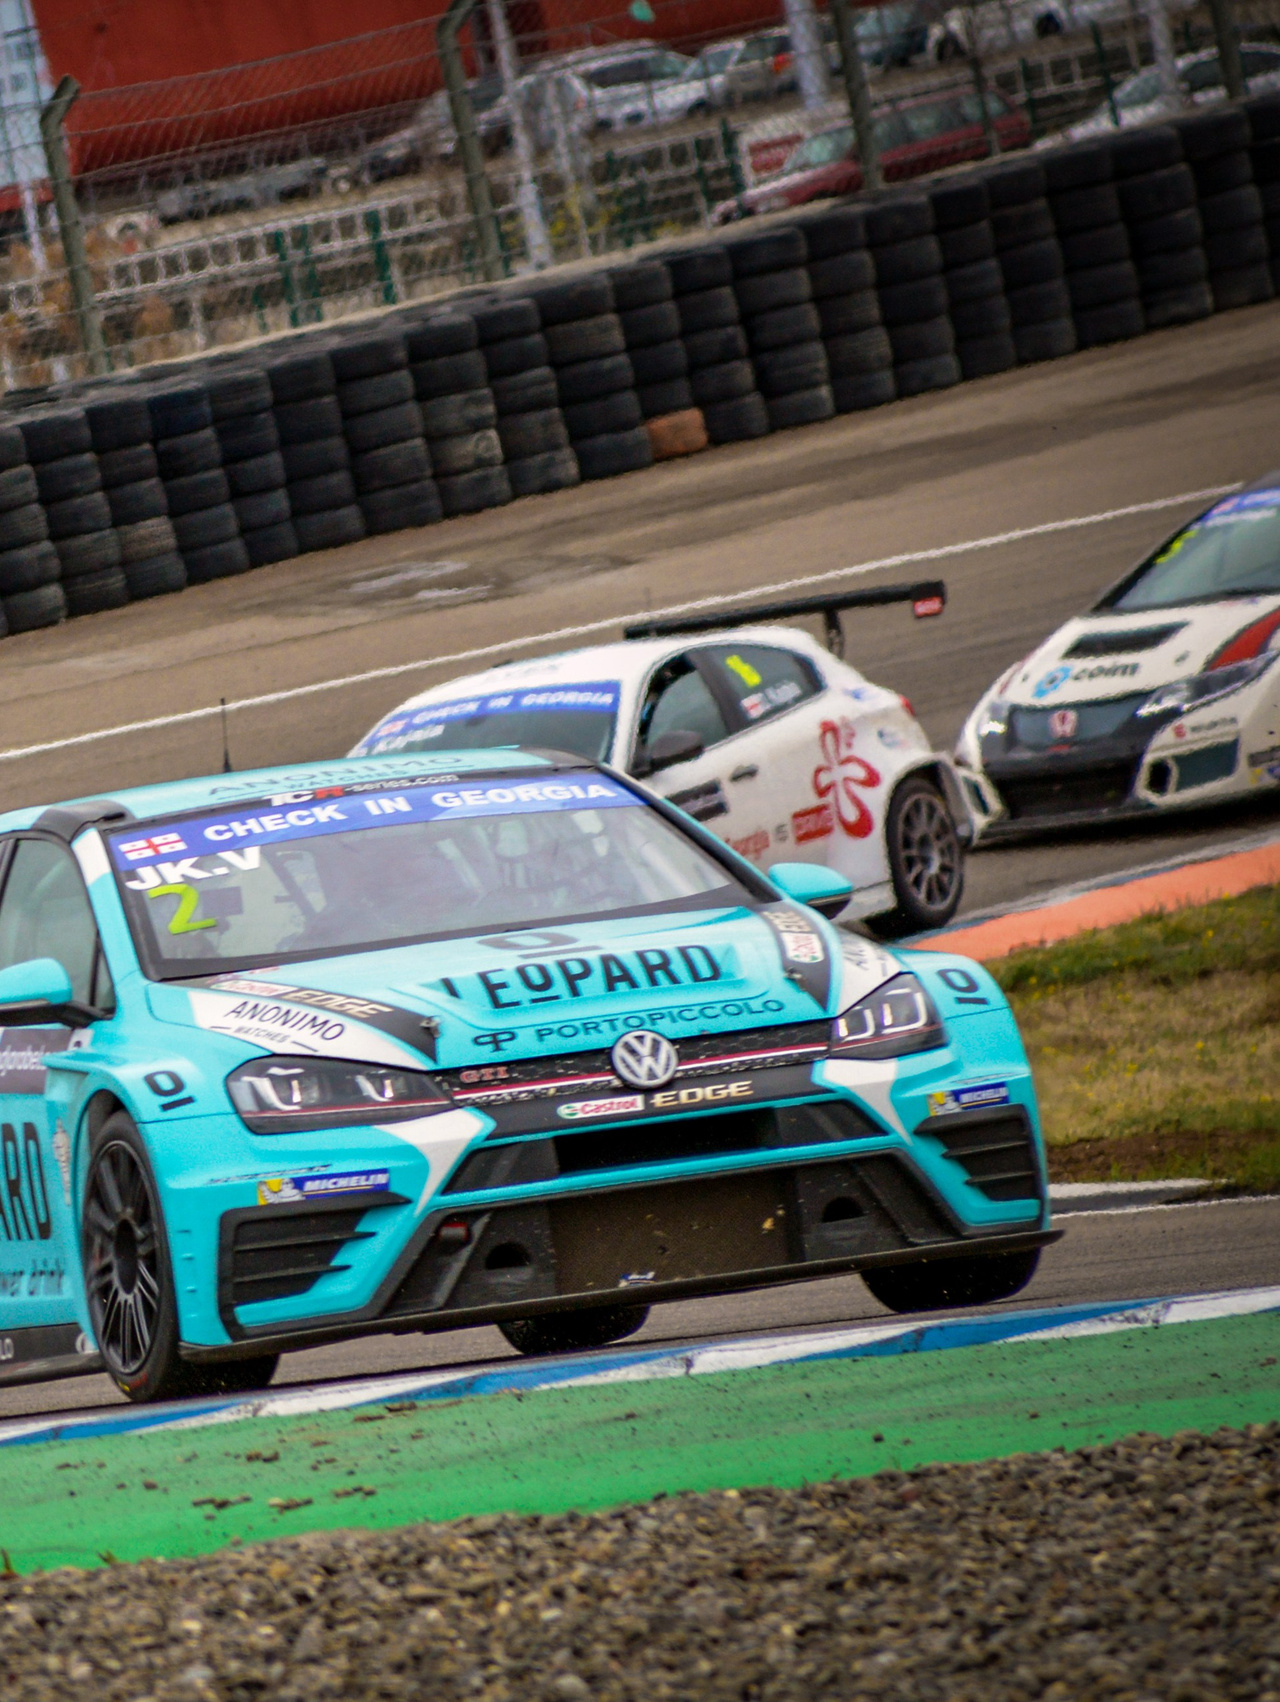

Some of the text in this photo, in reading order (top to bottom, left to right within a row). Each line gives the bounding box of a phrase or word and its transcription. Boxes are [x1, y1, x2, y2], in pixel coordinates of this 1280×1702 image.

[520, 690, 615, 706] GEORGIA
[202, 782, 618, 842] CHECK IN GEORGIA
[148, 883, 216, 936] 2
[438, 944, 722, 1010] LEOPARD
[223, 1001, 346, 1041] ANONIMO
[282, 990, 395, 1018] EDGE
[534, 999, 785, 1043] PORTOPICCOLO
[233, 1026, 291, 1044] WATCHES
[459, 1066, 509, 1085] GTI
[577, 1080, 754, 1116] Castrol EDGE
[303, 1173, 389, 1191] MICHELIN
